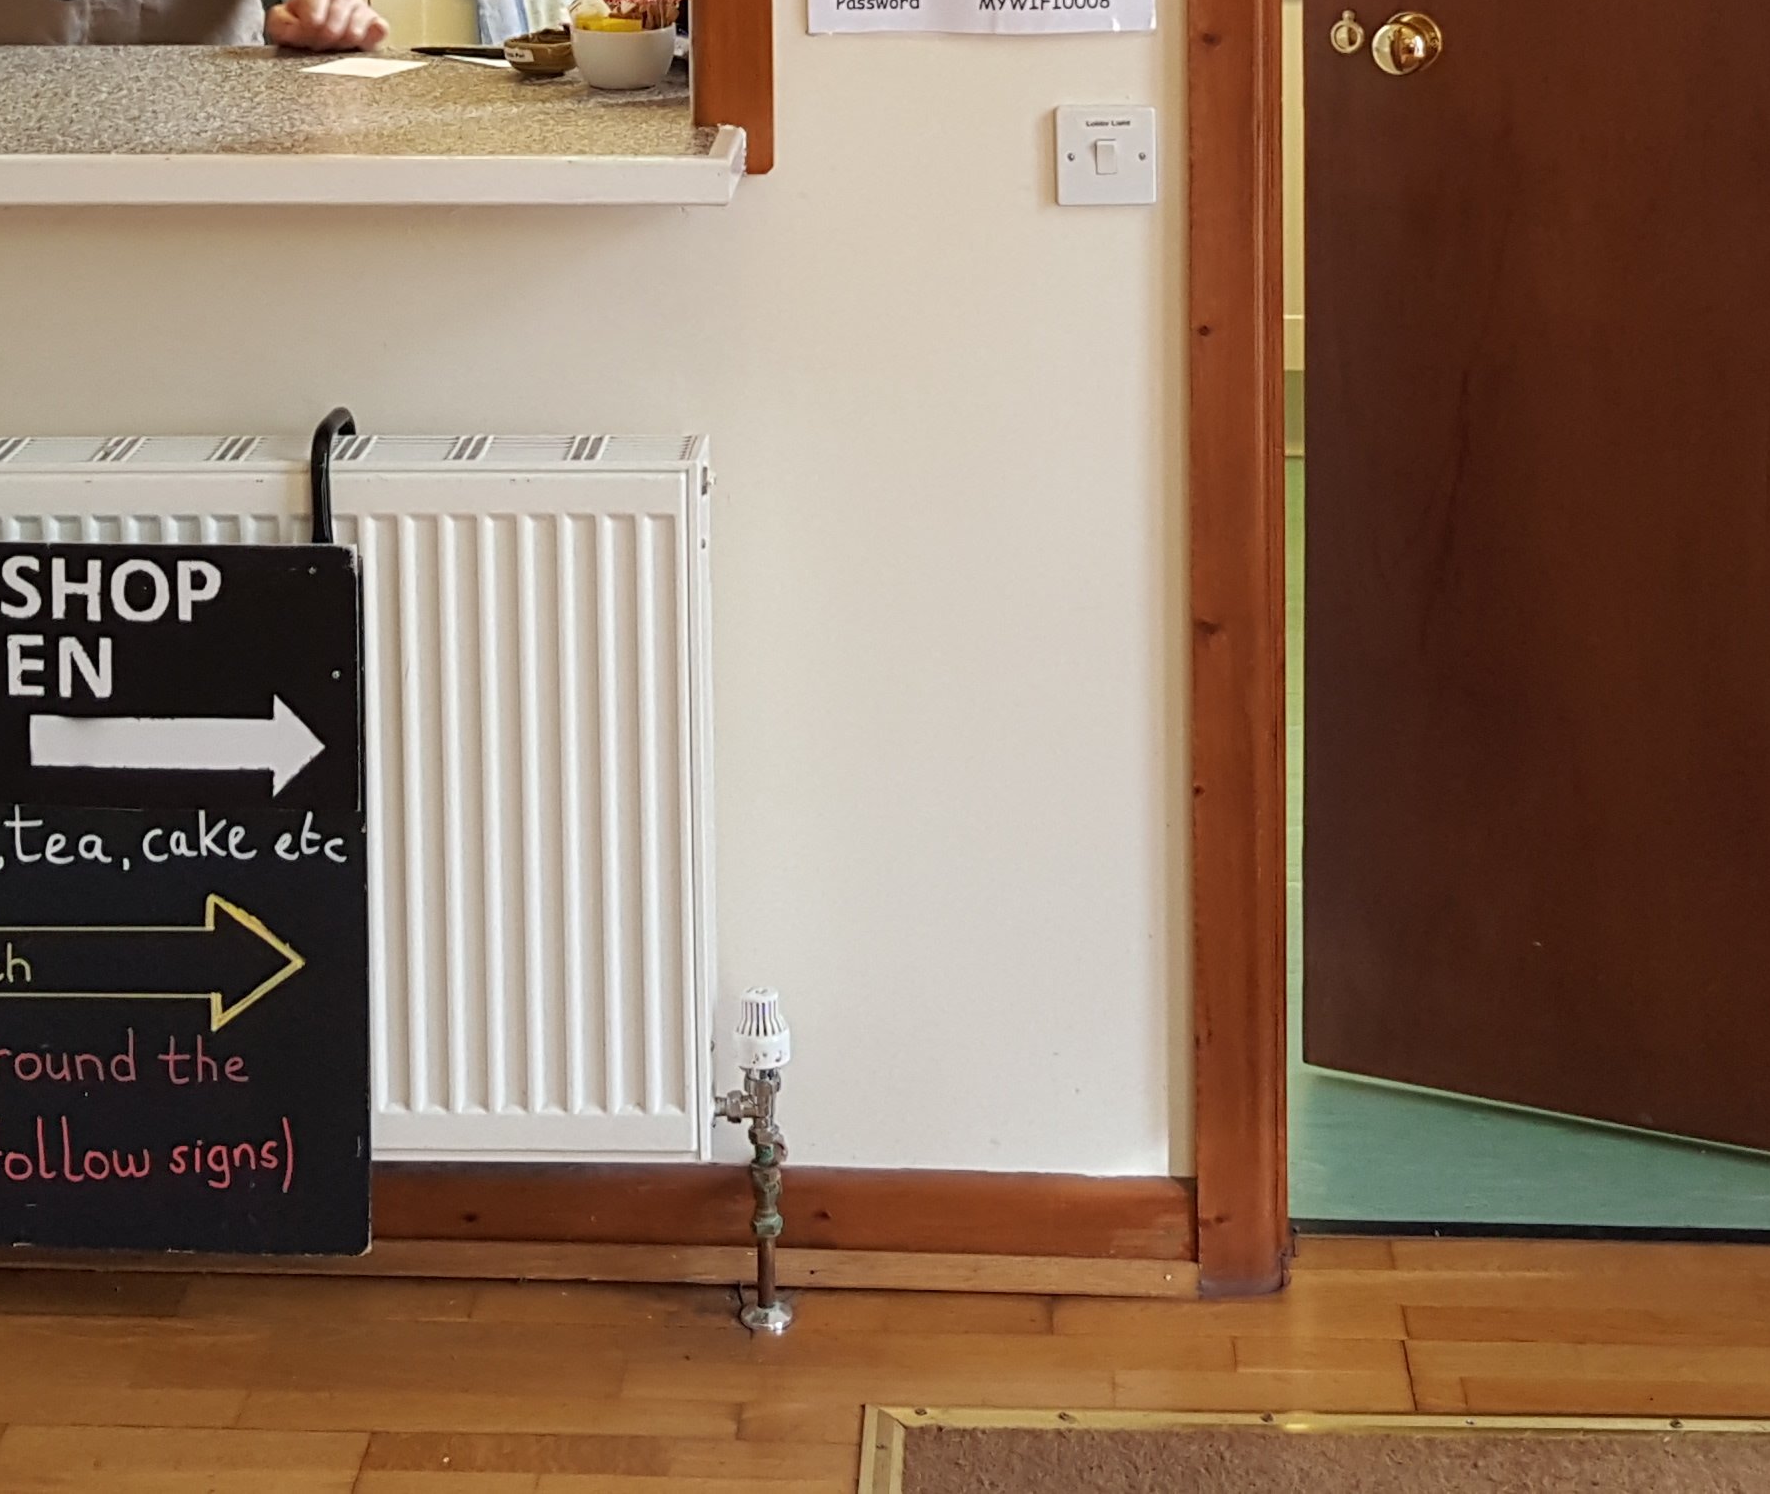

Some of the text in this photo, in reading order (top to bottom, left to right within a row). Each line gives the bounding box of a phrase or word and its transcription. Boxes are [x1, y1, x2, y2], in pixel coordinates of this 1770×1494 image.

[1, 556, 222, 622] SHOP
[143, 810, 257, 860] cake
[274, 811, 348, 863] etc
[158, 1034, 249, 1083] the
[168, 1116, 292, 1192] signs)
